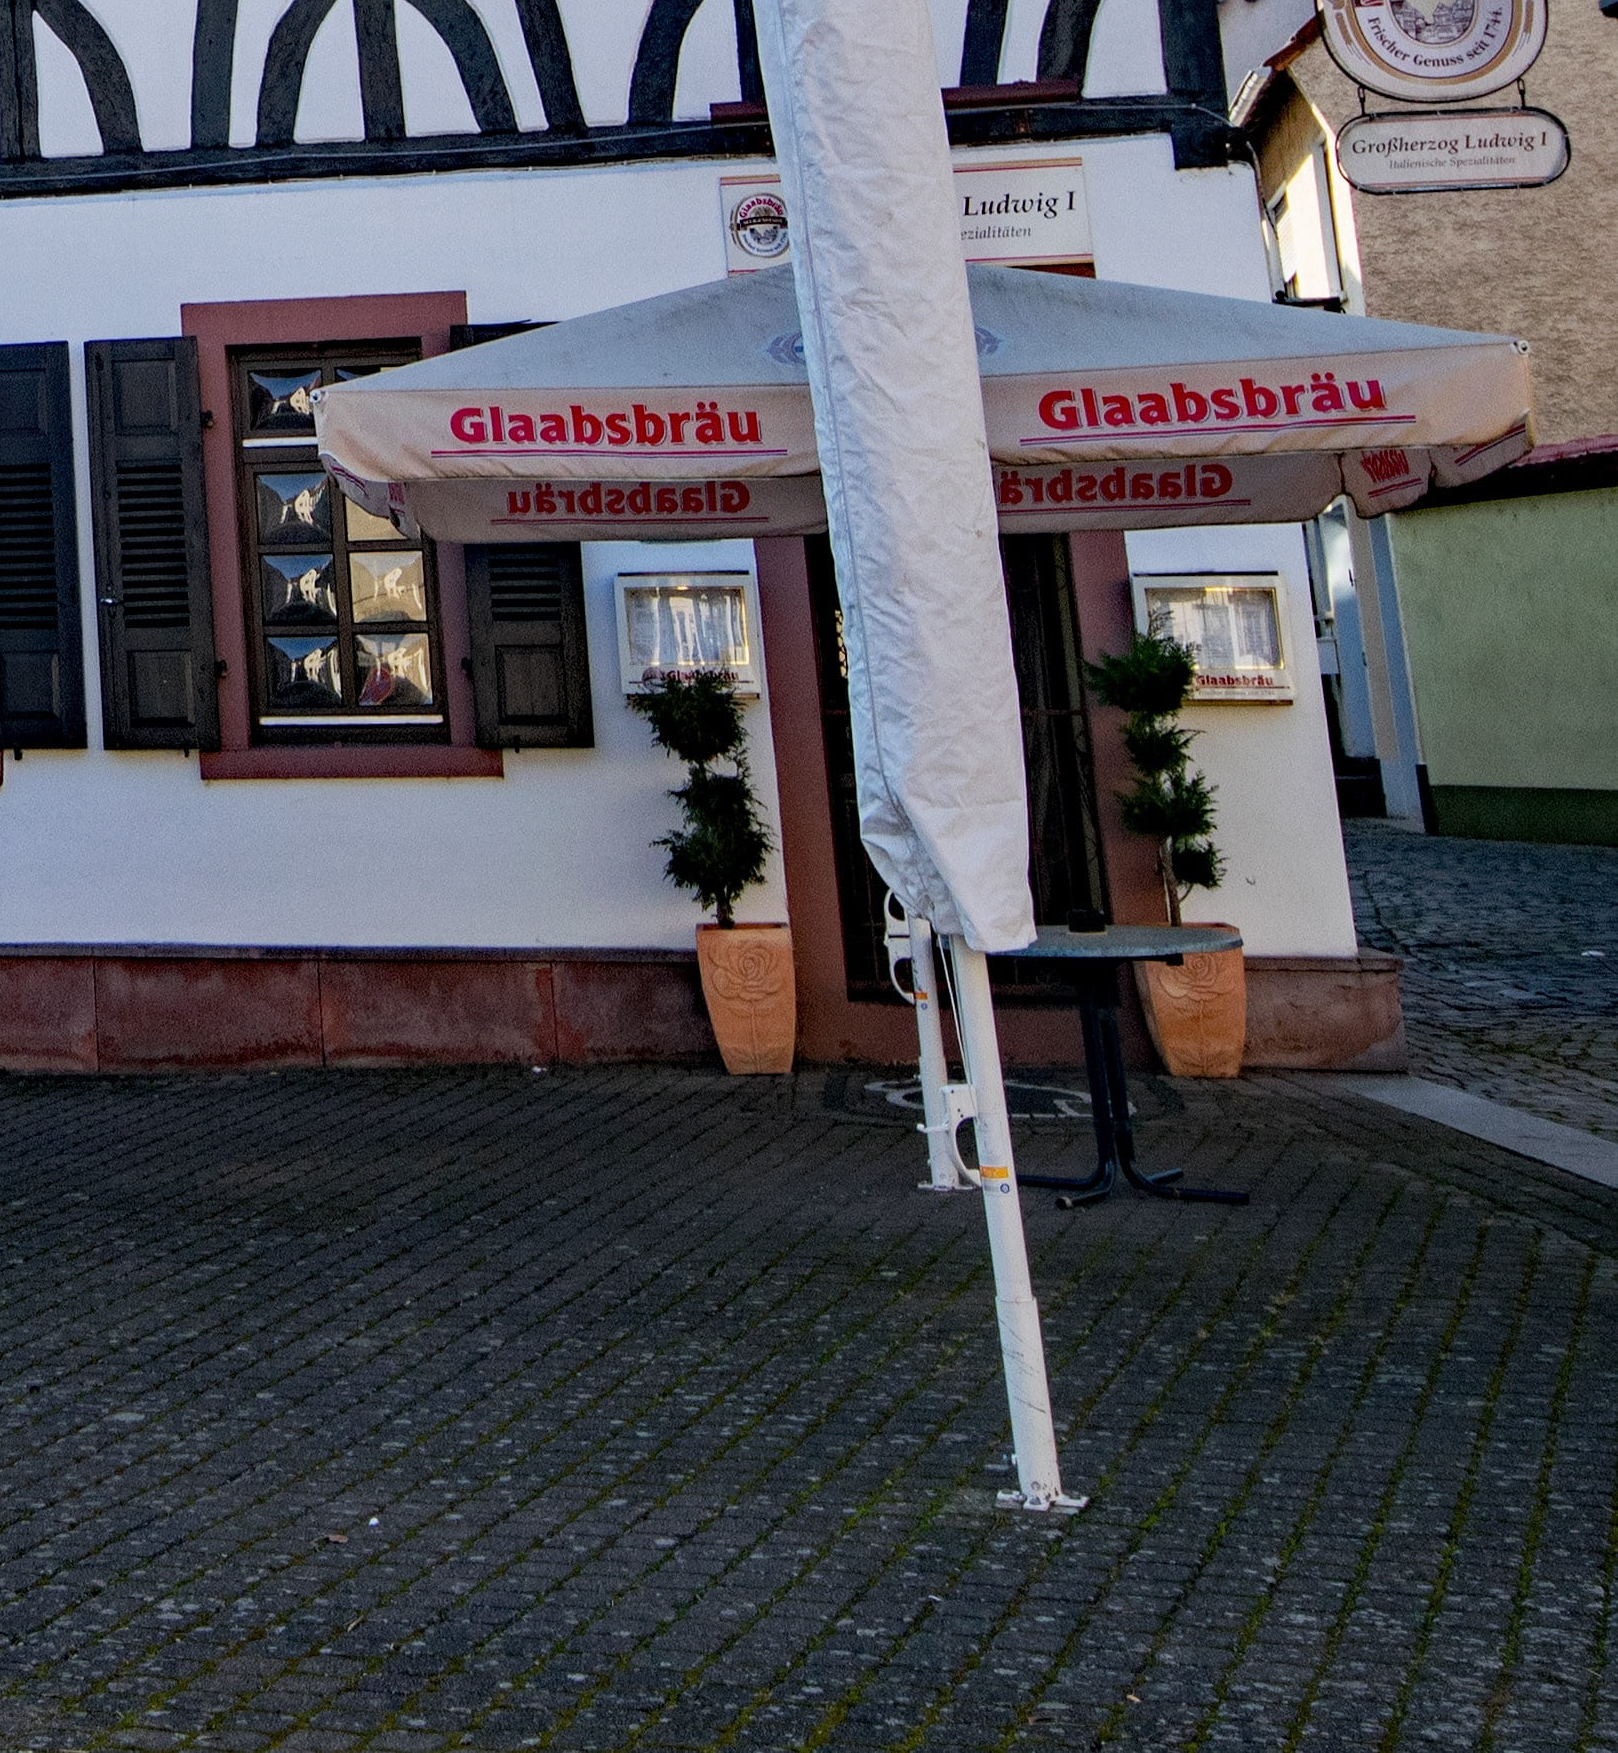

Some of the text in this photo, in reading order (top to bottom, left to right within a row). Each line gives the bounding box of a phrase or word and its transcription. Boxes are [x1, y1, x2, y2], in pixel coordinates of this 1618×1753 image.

[1367, 16, 1411, 61] Frischer
[1413, 52, 1465, 68] Genuss
[1467, 40, 1491, 61] seit
[1352, 131, 1548, 158] Großherzog Ludwig I
[1388, 155, 1516, 169] Italienische Spezialitäten
[963, 190, 1076, 219] Ludwig I
[960, 225, 1032, 241] ezialitäten
[1038, 372, 1388, 430] Glaabsbräu
[449, 401, 763, 446] Glaabsbräu
[1195, 674, 1274, 686] Glaabsbräu
